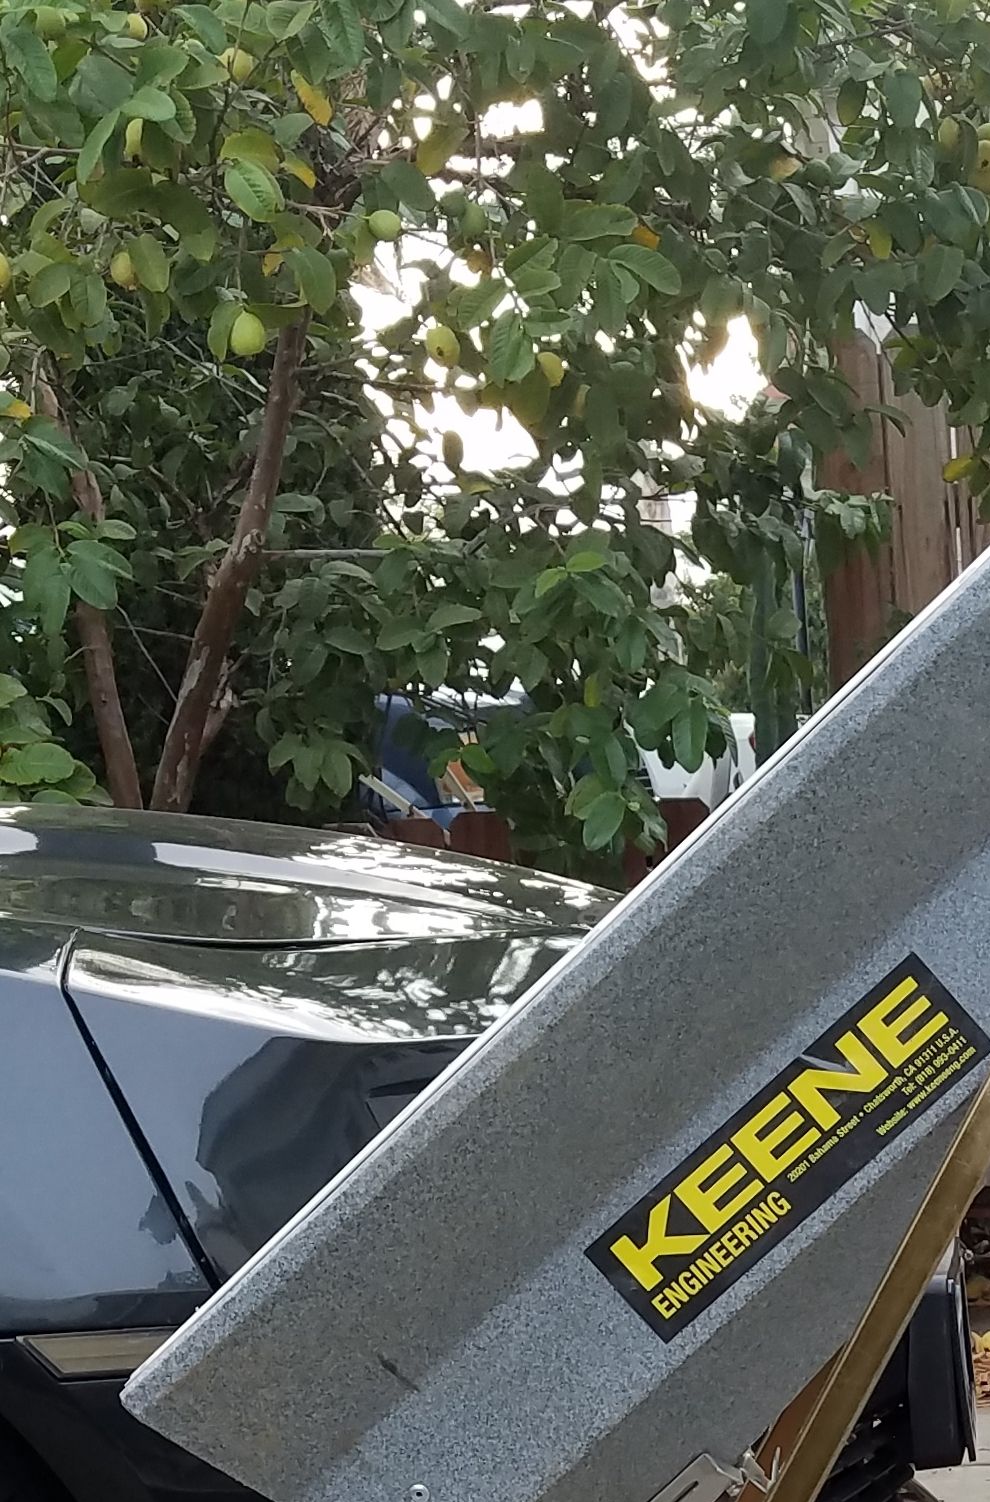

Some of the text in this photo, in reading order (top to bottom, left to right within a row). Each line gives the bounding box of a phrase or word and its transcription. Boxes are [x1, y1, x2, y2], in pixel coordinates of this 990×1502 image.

[610, 976, 949, 1292] KEENE
[787, 1159, 811, 1183] 20201
[836, 1115, 861, 1138] Street
[863, 1075, 907, 1113] Chatsworth,
[903, 1064, 918, 1078] CA
[914, 1046, 938, 1068] 91311
[935, 1027, 960, 1049] U.S.A.
[876, 1107, 908, 1136] Website:
[901, 1081, 918, 1096] Tel:
[915, 1065, 936, 1086] (818)
[651, 1190, 792, 1319] ENGINEERING
